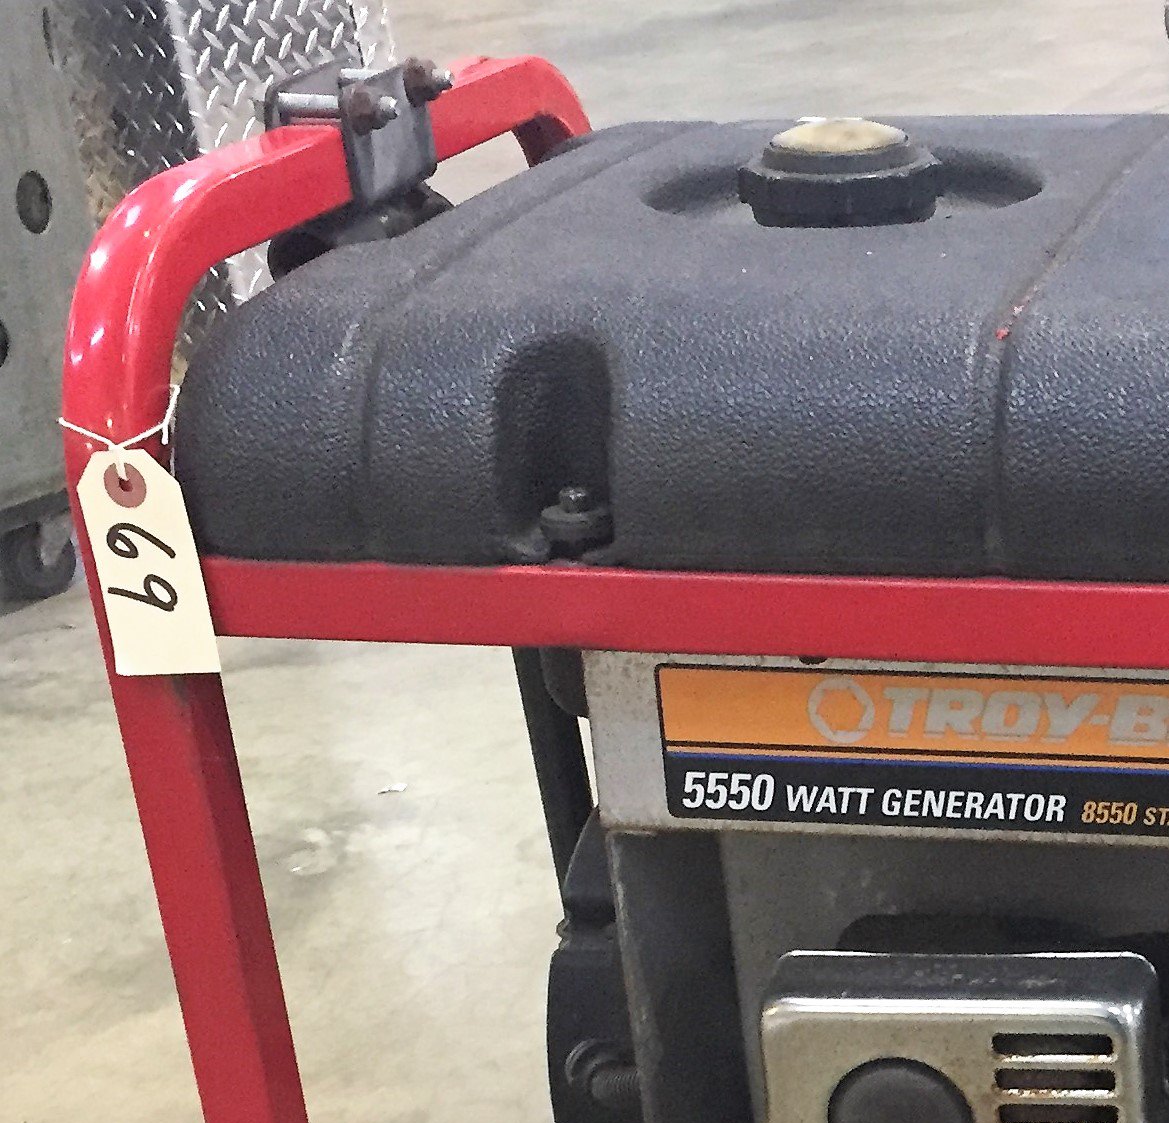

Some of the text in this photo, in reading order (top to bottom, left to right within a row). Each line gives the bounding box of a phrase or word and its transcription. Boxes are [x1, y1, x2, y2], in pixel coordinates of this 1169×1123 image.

[106, 522, 178, 612] 69
[682, 772, 775, 811] 5550
[786, 785, 874, 815] WATT
[882, 789, 1067, 822] GENERATOR
[1081, 801, 1138, 826] 8550
